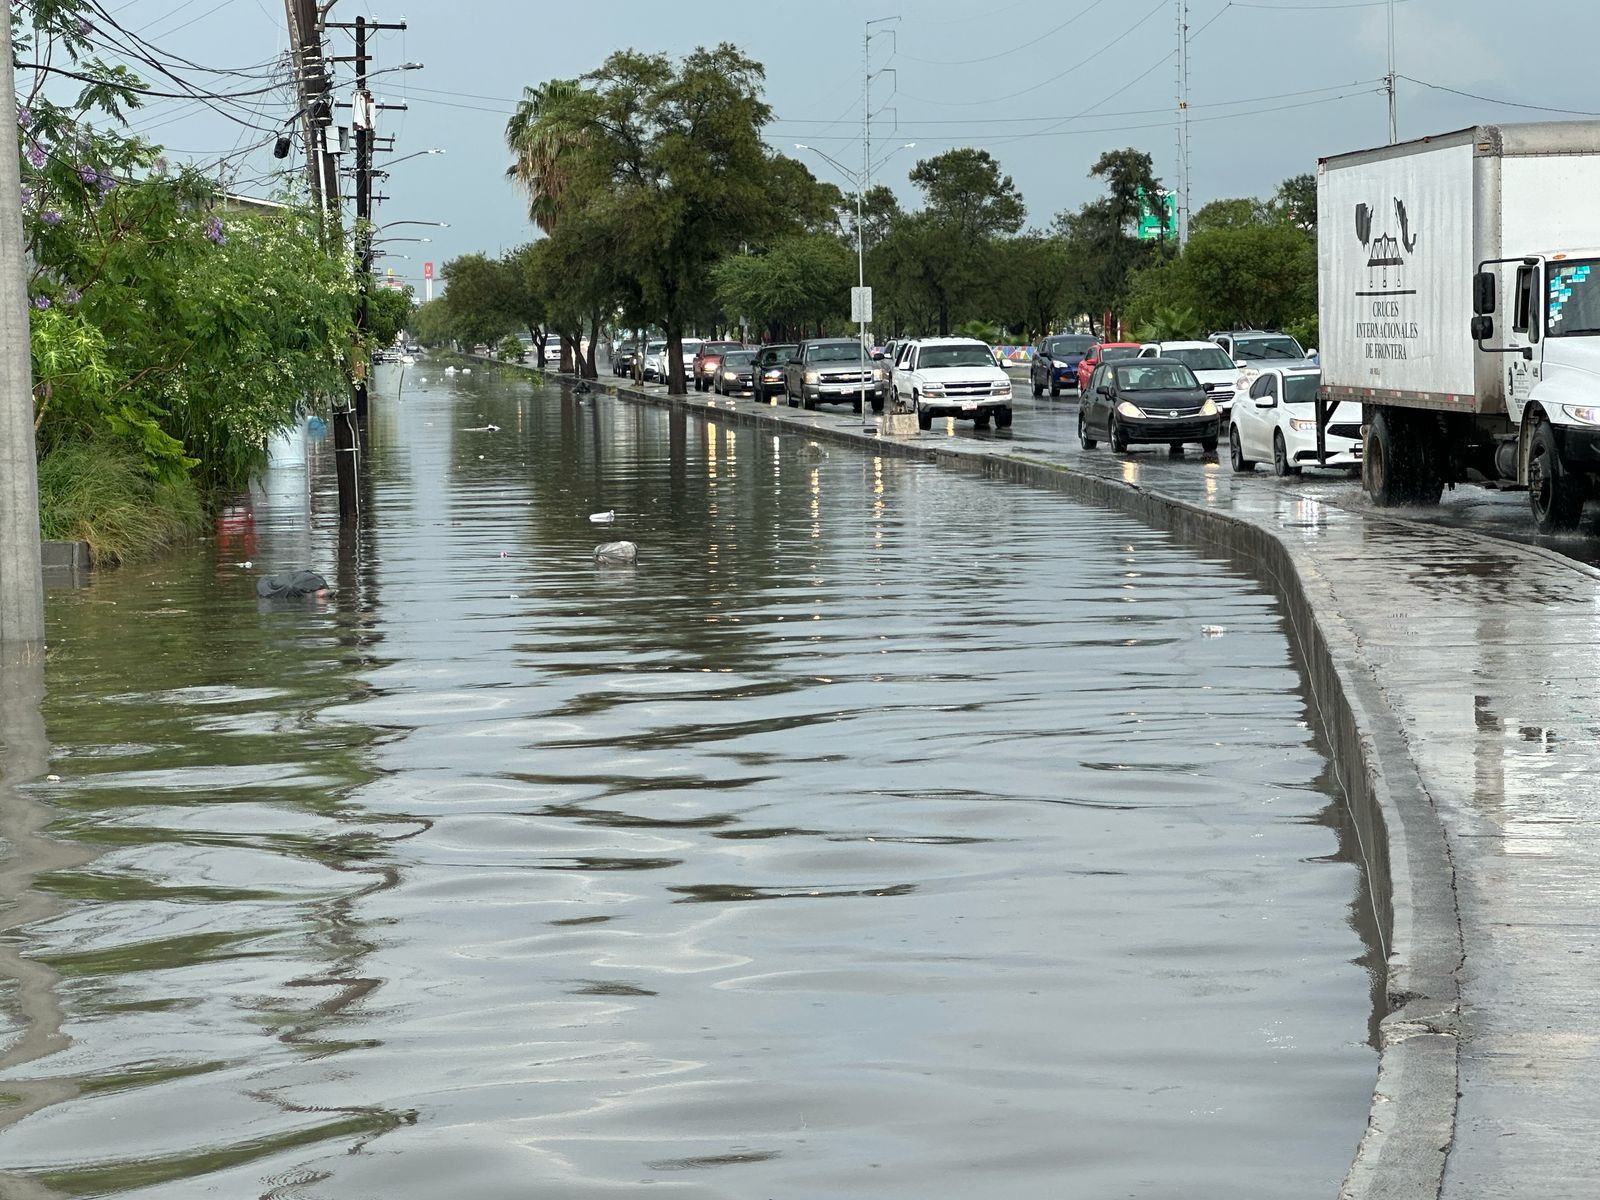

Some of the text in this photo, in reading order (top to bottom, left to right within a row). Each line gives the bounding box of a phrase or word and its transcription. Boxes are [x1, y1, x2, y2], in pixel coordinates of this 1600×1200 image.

[1372, 301, 1399, 317] CRUCES
[1356, 322, 1418, 338] INTERNACIONALES
[1365, 343, 1407, 360] DE FRONTERA
